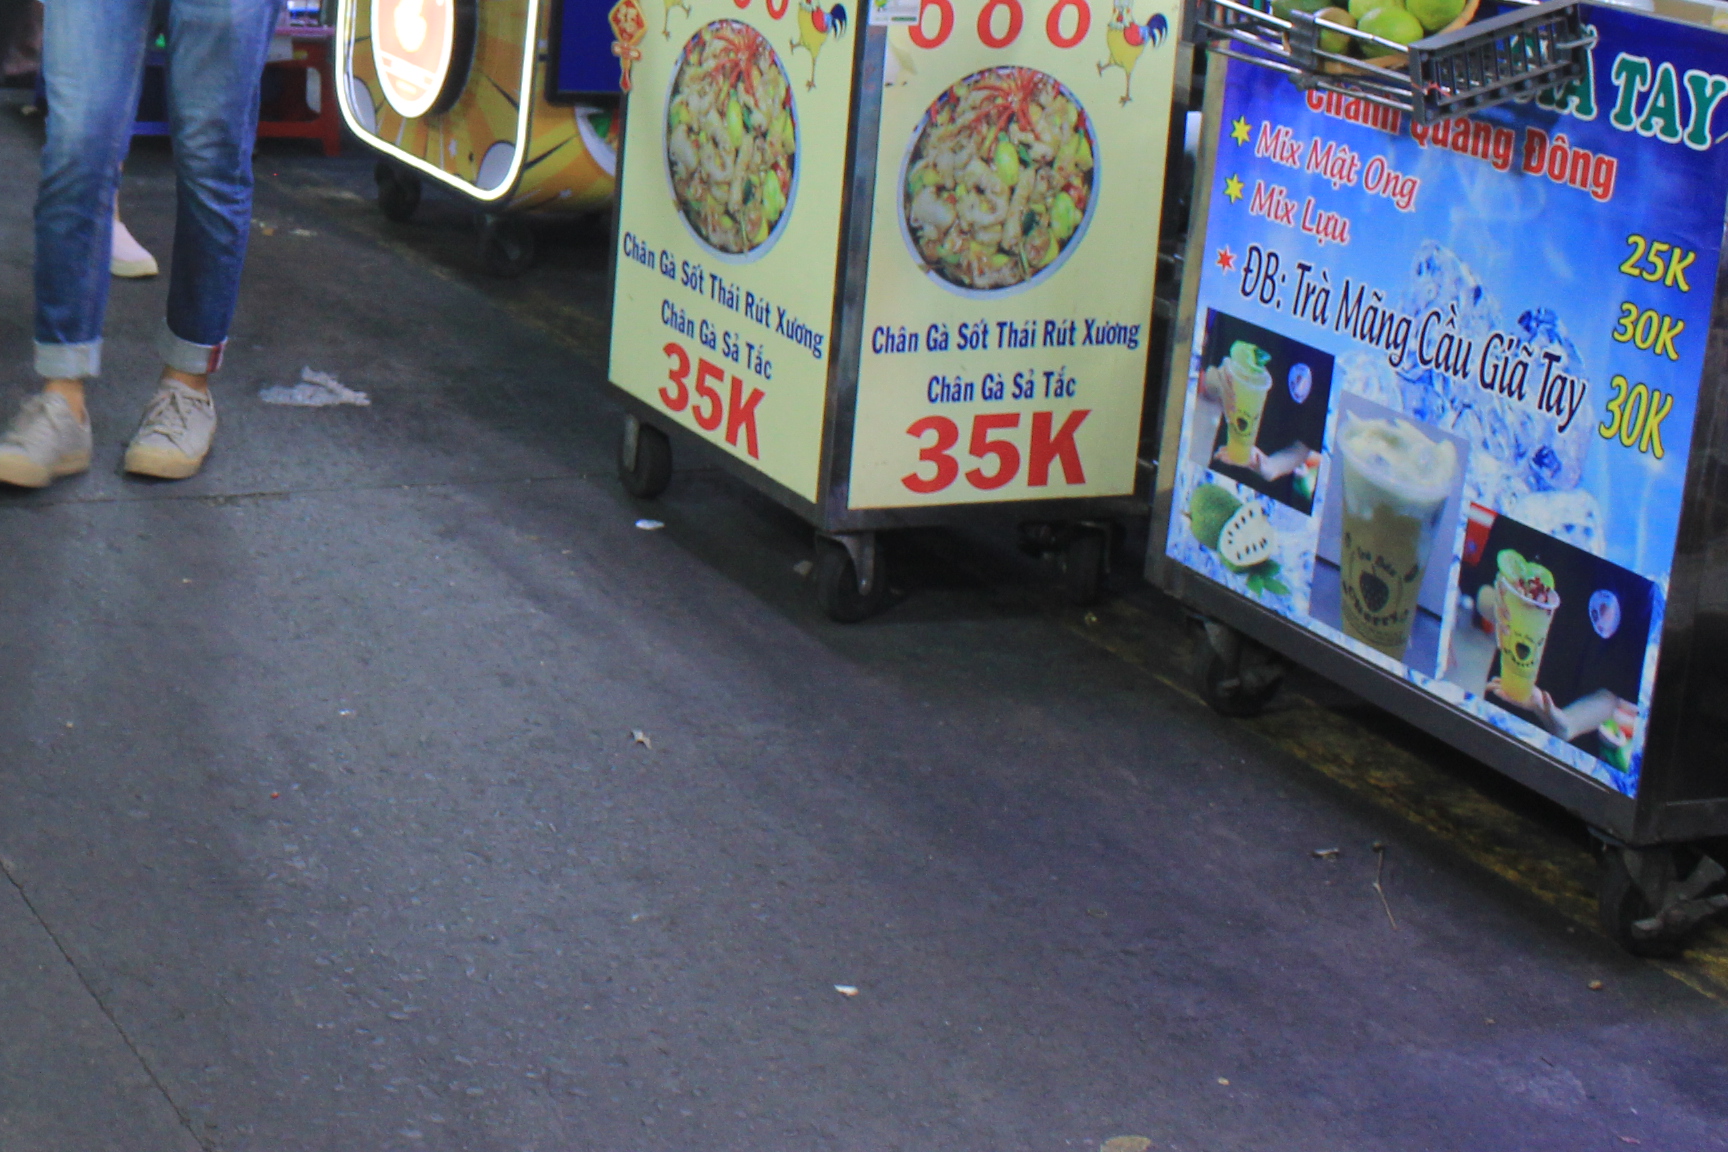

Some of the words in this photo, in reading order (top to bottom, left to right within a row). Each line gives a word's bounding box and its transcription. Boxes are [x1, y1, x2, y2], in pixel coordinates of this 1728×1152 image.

[1611, 52, 1728, 150] TAY
[1256, 121, 1303, 166] Mix
[1306, 138, 1361, 189] Mật
[1364, 157, 1420, 211] Ong
[1522, 126, 1617, 202] Đông
[1250, 180, 1297, 226] Mix
[1301, 197, 1350, 244] Lựu
[623, 231, 656, 270] Chân
[659, 249, 676, 280] Gà
[680, 259, 705, 295] Sốt
[709, 272, 740, 312] Thái
[745, 291, 771, 328] Rút
[775, 306, 824, 360] Xương
[1619, 234, 1696, 293] 25K
[661, 299, 695, 339] Chân
[699, 318, 716, 350] Gà
[722, 331, 739, 363] Sả
[745, 342, 773, 381] Tắc
[871, 325, 919, 354] Chân
[926, 323, 949, 351] Gà
[956, 318, 990, 350] Sốt
[996, 320, 1037, 349] Thái
[1042, 318, 1076, 346] Rút
[1082, 317, 1141, 350] Xương
[1240, 244, 1286, 310] ĐB:
[1292, 261, 1332, 325] Trà
[1334, 279, 1412, 368] Mãng
[1417, 302, 1472, 379] Cầu
[1536, 350, 1587, 434] Tay
[1612, 301, 1685, 361] 30K
[658, 341, 766, 461] 35K
[927, 375, 974, 404] Chân
[981, 372, 1004, 401] Gà
[1012, 368, 1034, 399] Sả
[1042, 365, 1077, 398] Tắc
[1598, 374, 1674, 460] 30K
[900, 409, 1092, 494] 35K
